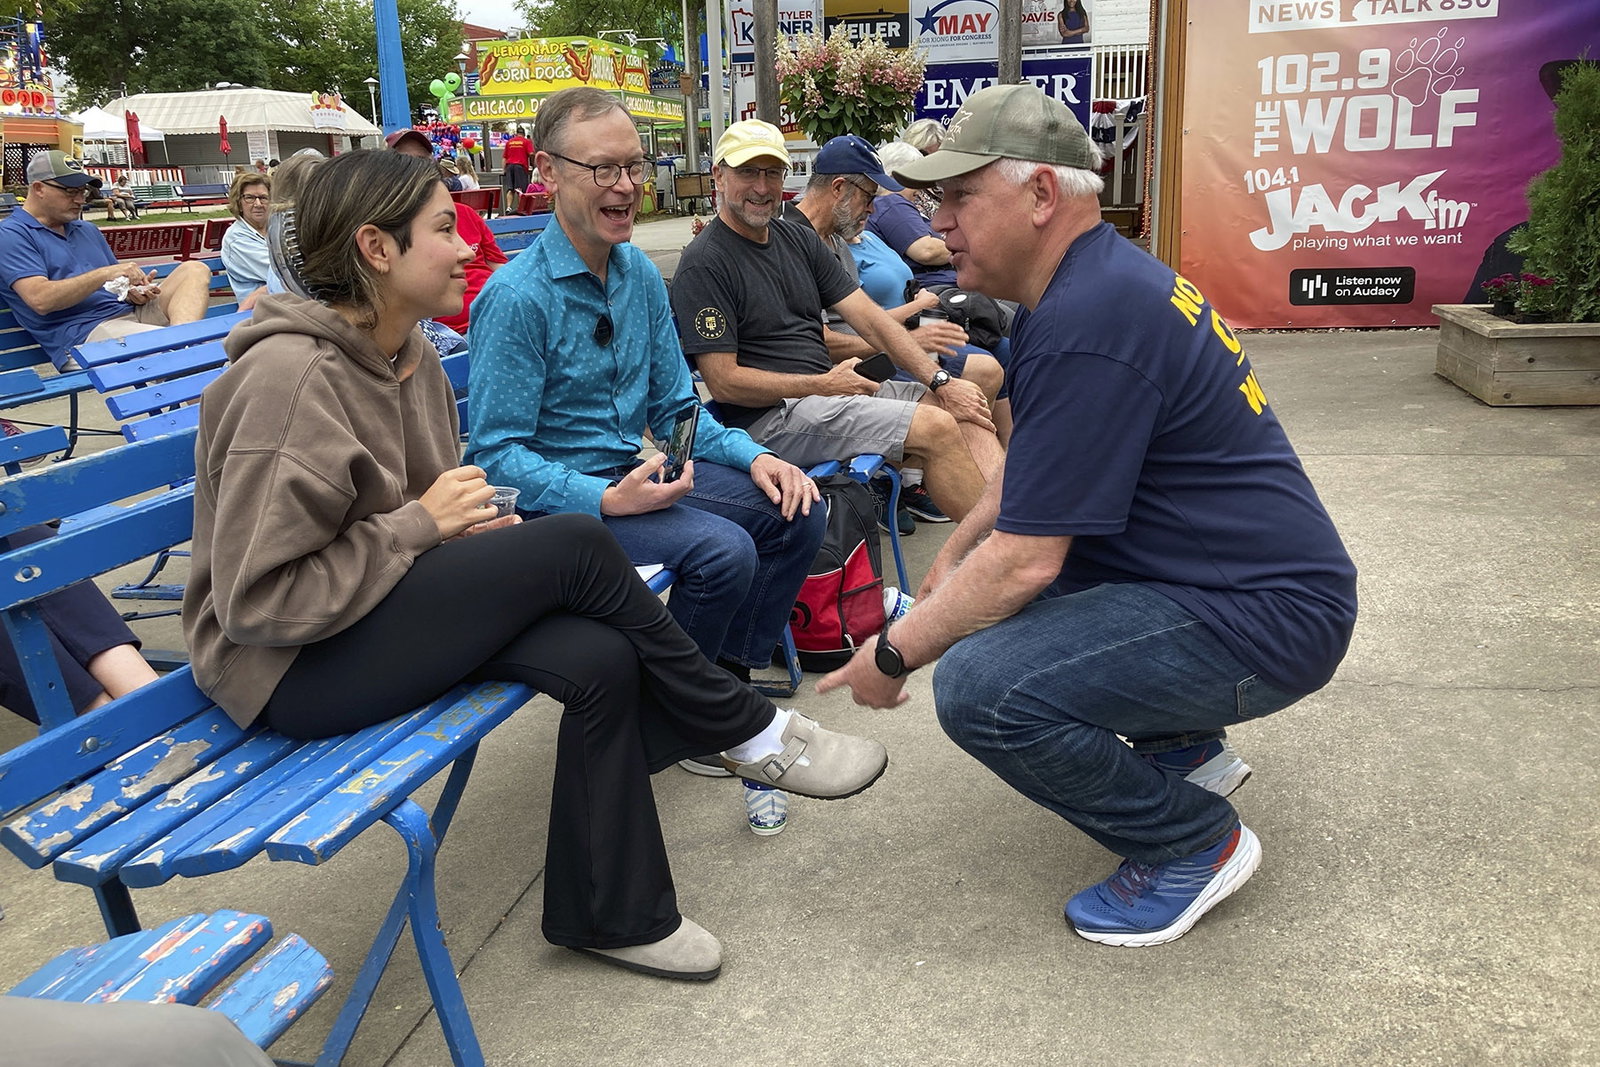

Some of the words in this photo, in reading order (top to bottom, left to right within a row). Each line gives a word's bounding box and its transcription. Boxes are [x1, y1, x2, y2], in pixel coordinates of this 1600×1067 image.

[780, 11, 813, 19] TYLER
[1258, 1, 1334, 23] NEWS
[1367, 0, 1433, 15] TALK
[742, 21, 814, 43] KNER
[938, 12, 992, 35] MAY
[950, 34, 961, 42] FOR
[962, 33, 992, 41] CONGRESS
[493, 43, 568, 57] LEMONADE
[493, 67, 530, 82] CORN
[535, 65, 573, 80] DOGS
[1258, 48, 1391, 95] 102.9
[469, 98, 525, 115] CHICAGO
[1253, 100, 1281, 158] THE
[1284, 88, 1480, 155] WOLF
[1243, 166, 1300, 194] 104.1
[1249, 169, 1447, 251] JACK
[1293, 236, 1348, 251] playing
[1353, 234, 1391, 247] what
[1395, 236, 1418, 246] we
[1423, 232, 1463, 245] want
[1335, 276, 1373, 286] Listen
[1375, 277, 1402, 285] now
[1335, 288, 1351, 297] on
[1353, 286, 1401, 298] Audacy
